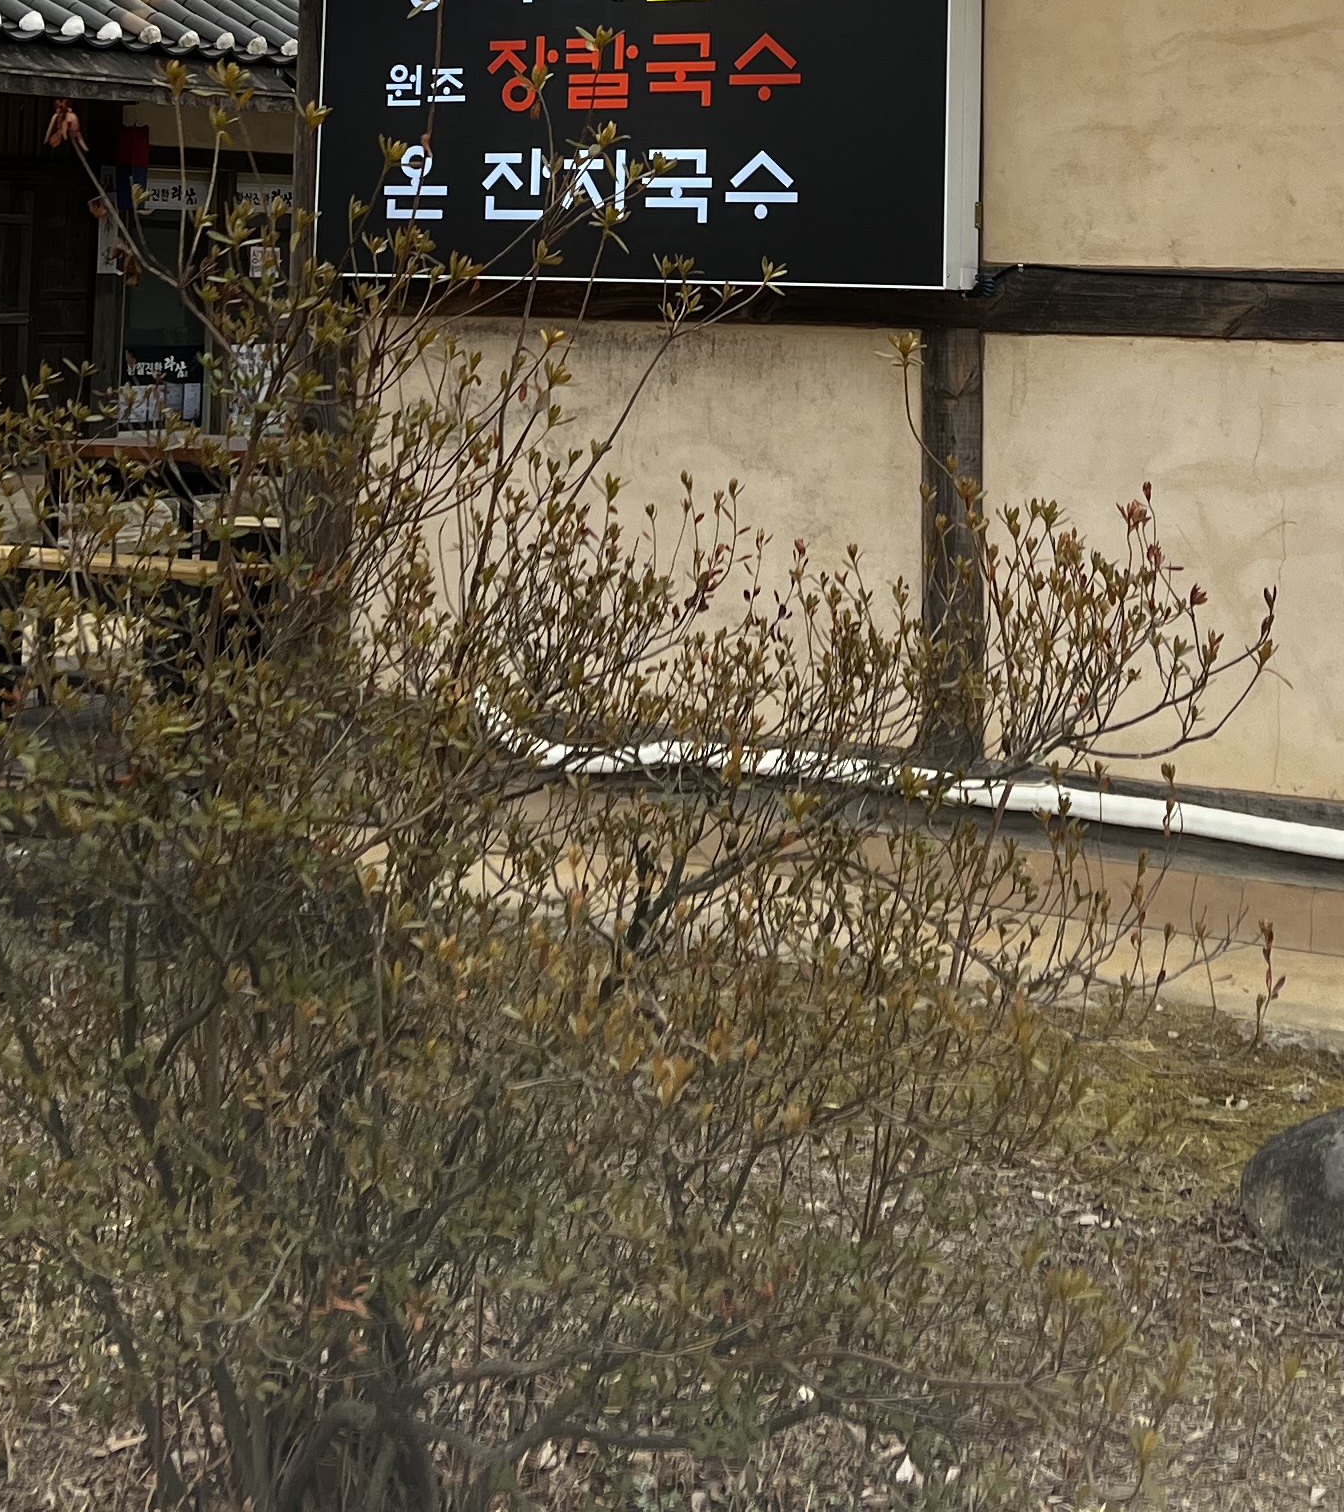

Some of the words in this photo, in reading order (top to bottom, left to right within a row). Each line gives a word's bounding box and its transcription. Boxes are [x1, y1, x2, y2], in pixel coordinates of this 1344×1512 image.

[386, 64, 466, 107] 원조
[487, 33, 801, 112] 장칼국수
[384, 145, 448, 221] 온
[481, 148, 798, 224] 잔치국수
